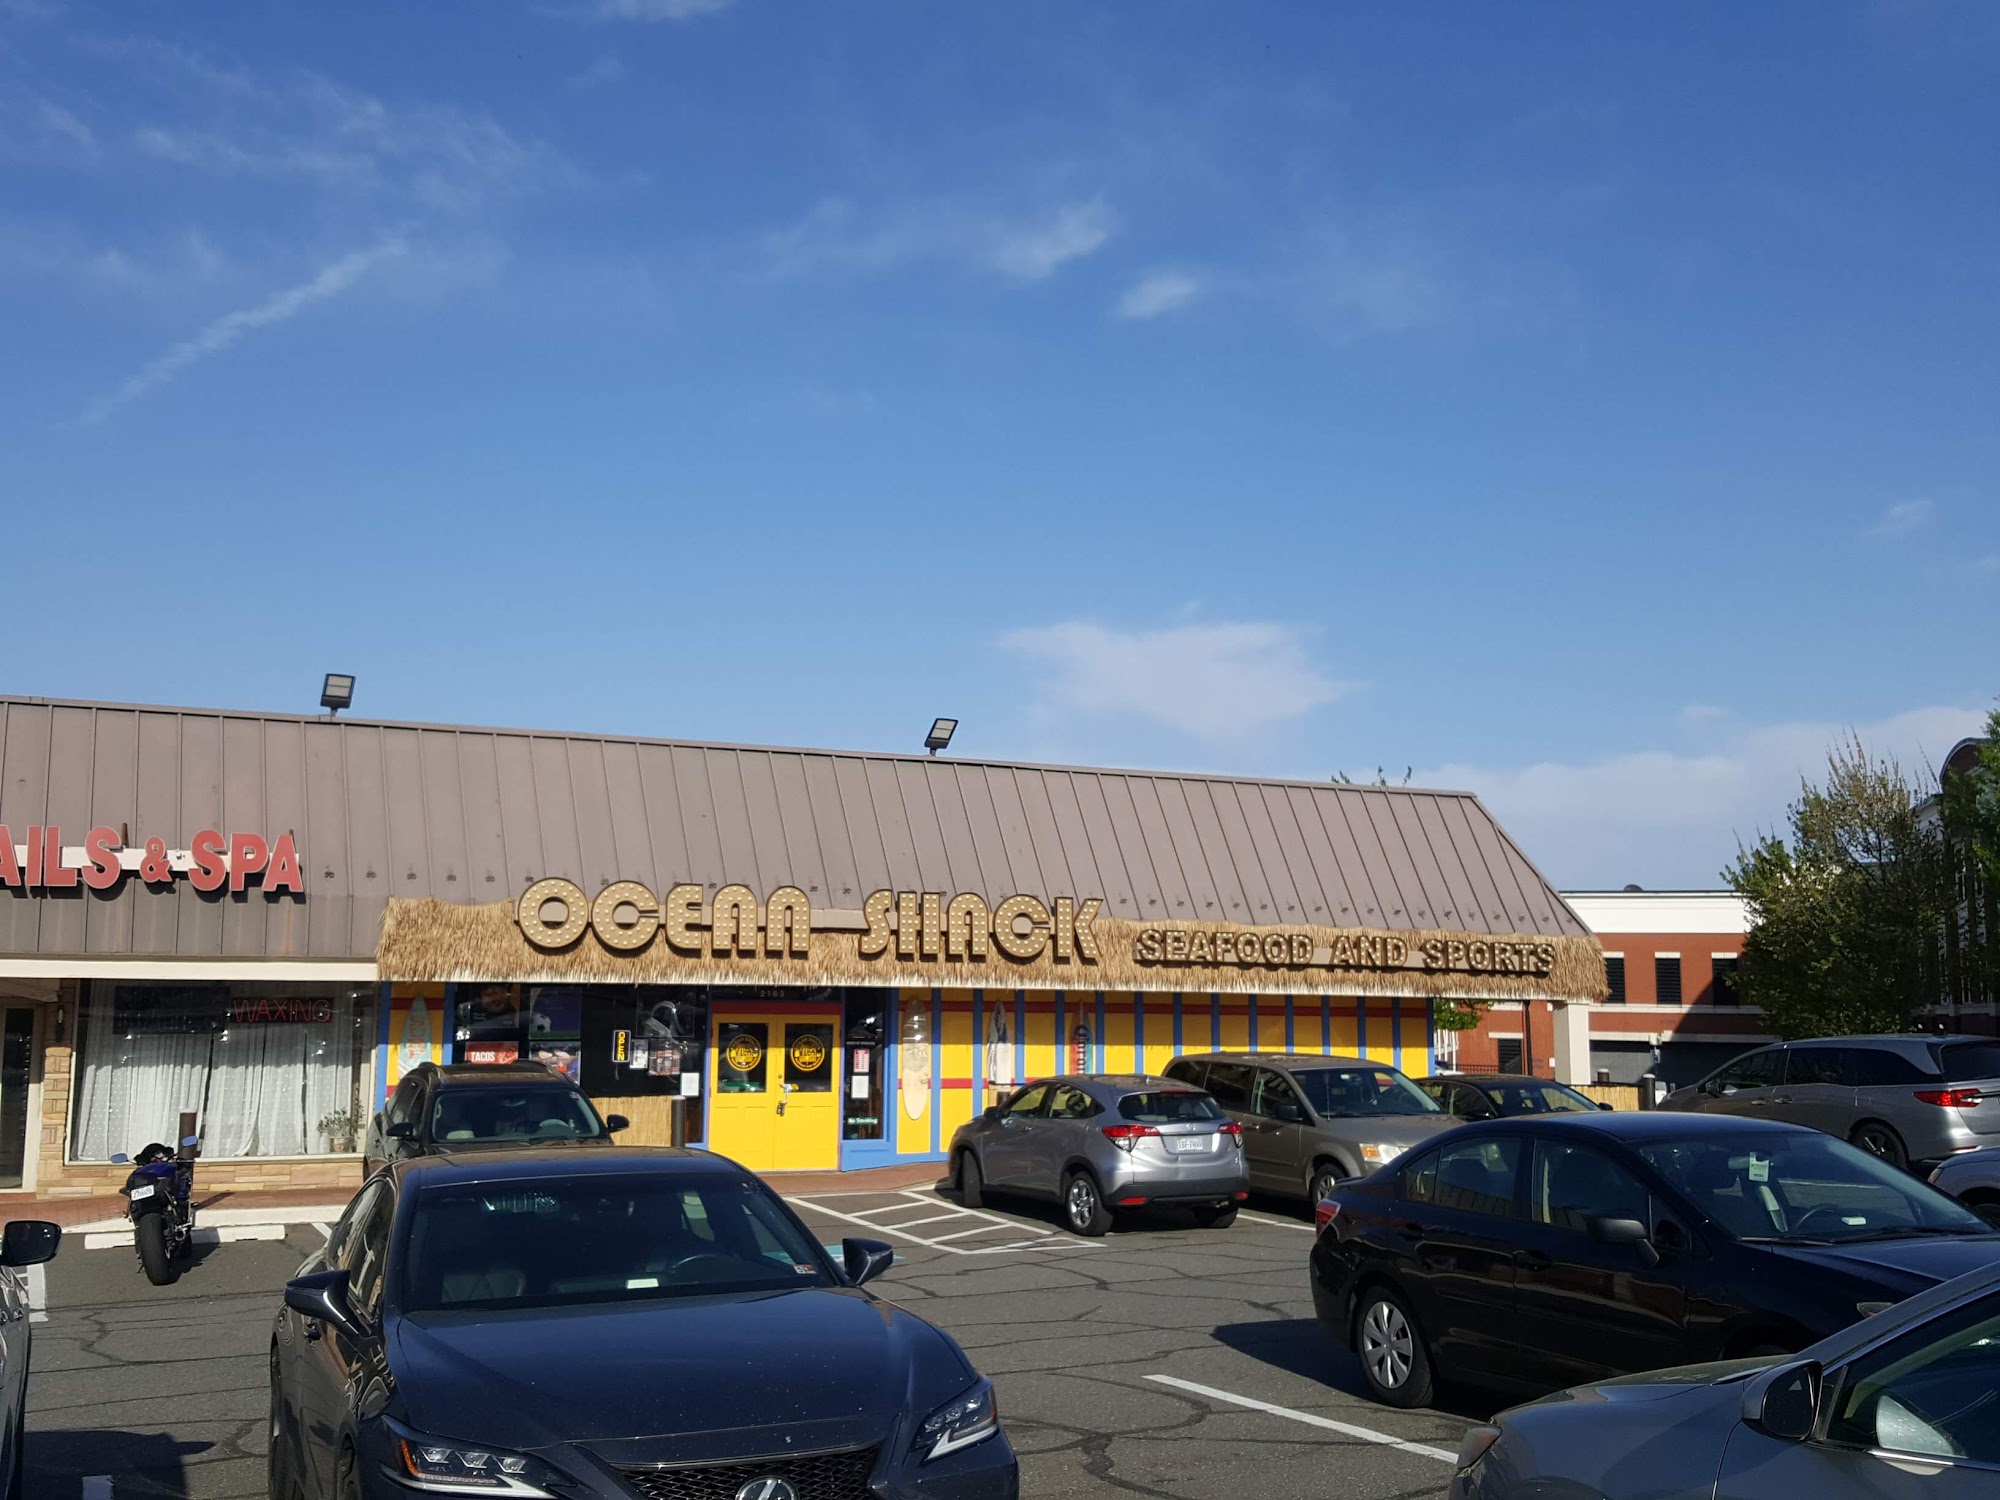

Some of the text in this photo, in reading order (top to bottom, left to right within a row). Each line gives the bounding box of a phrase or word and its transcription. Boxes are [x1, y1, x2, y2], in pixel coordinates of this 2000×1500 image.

[139, 836, 172, 883] &
[188, 829, 304, 893] SPA
[517, 877, 1103, 959] OCEAN SHACK
[1136, 928, 1556, 975] SEAFOOD AND SPORTS
[233, 1000, 330, 1023] WAXING
[470, 1051, 496, 1062] TACOS
[617, 1031, 626, 1061] OPEN
